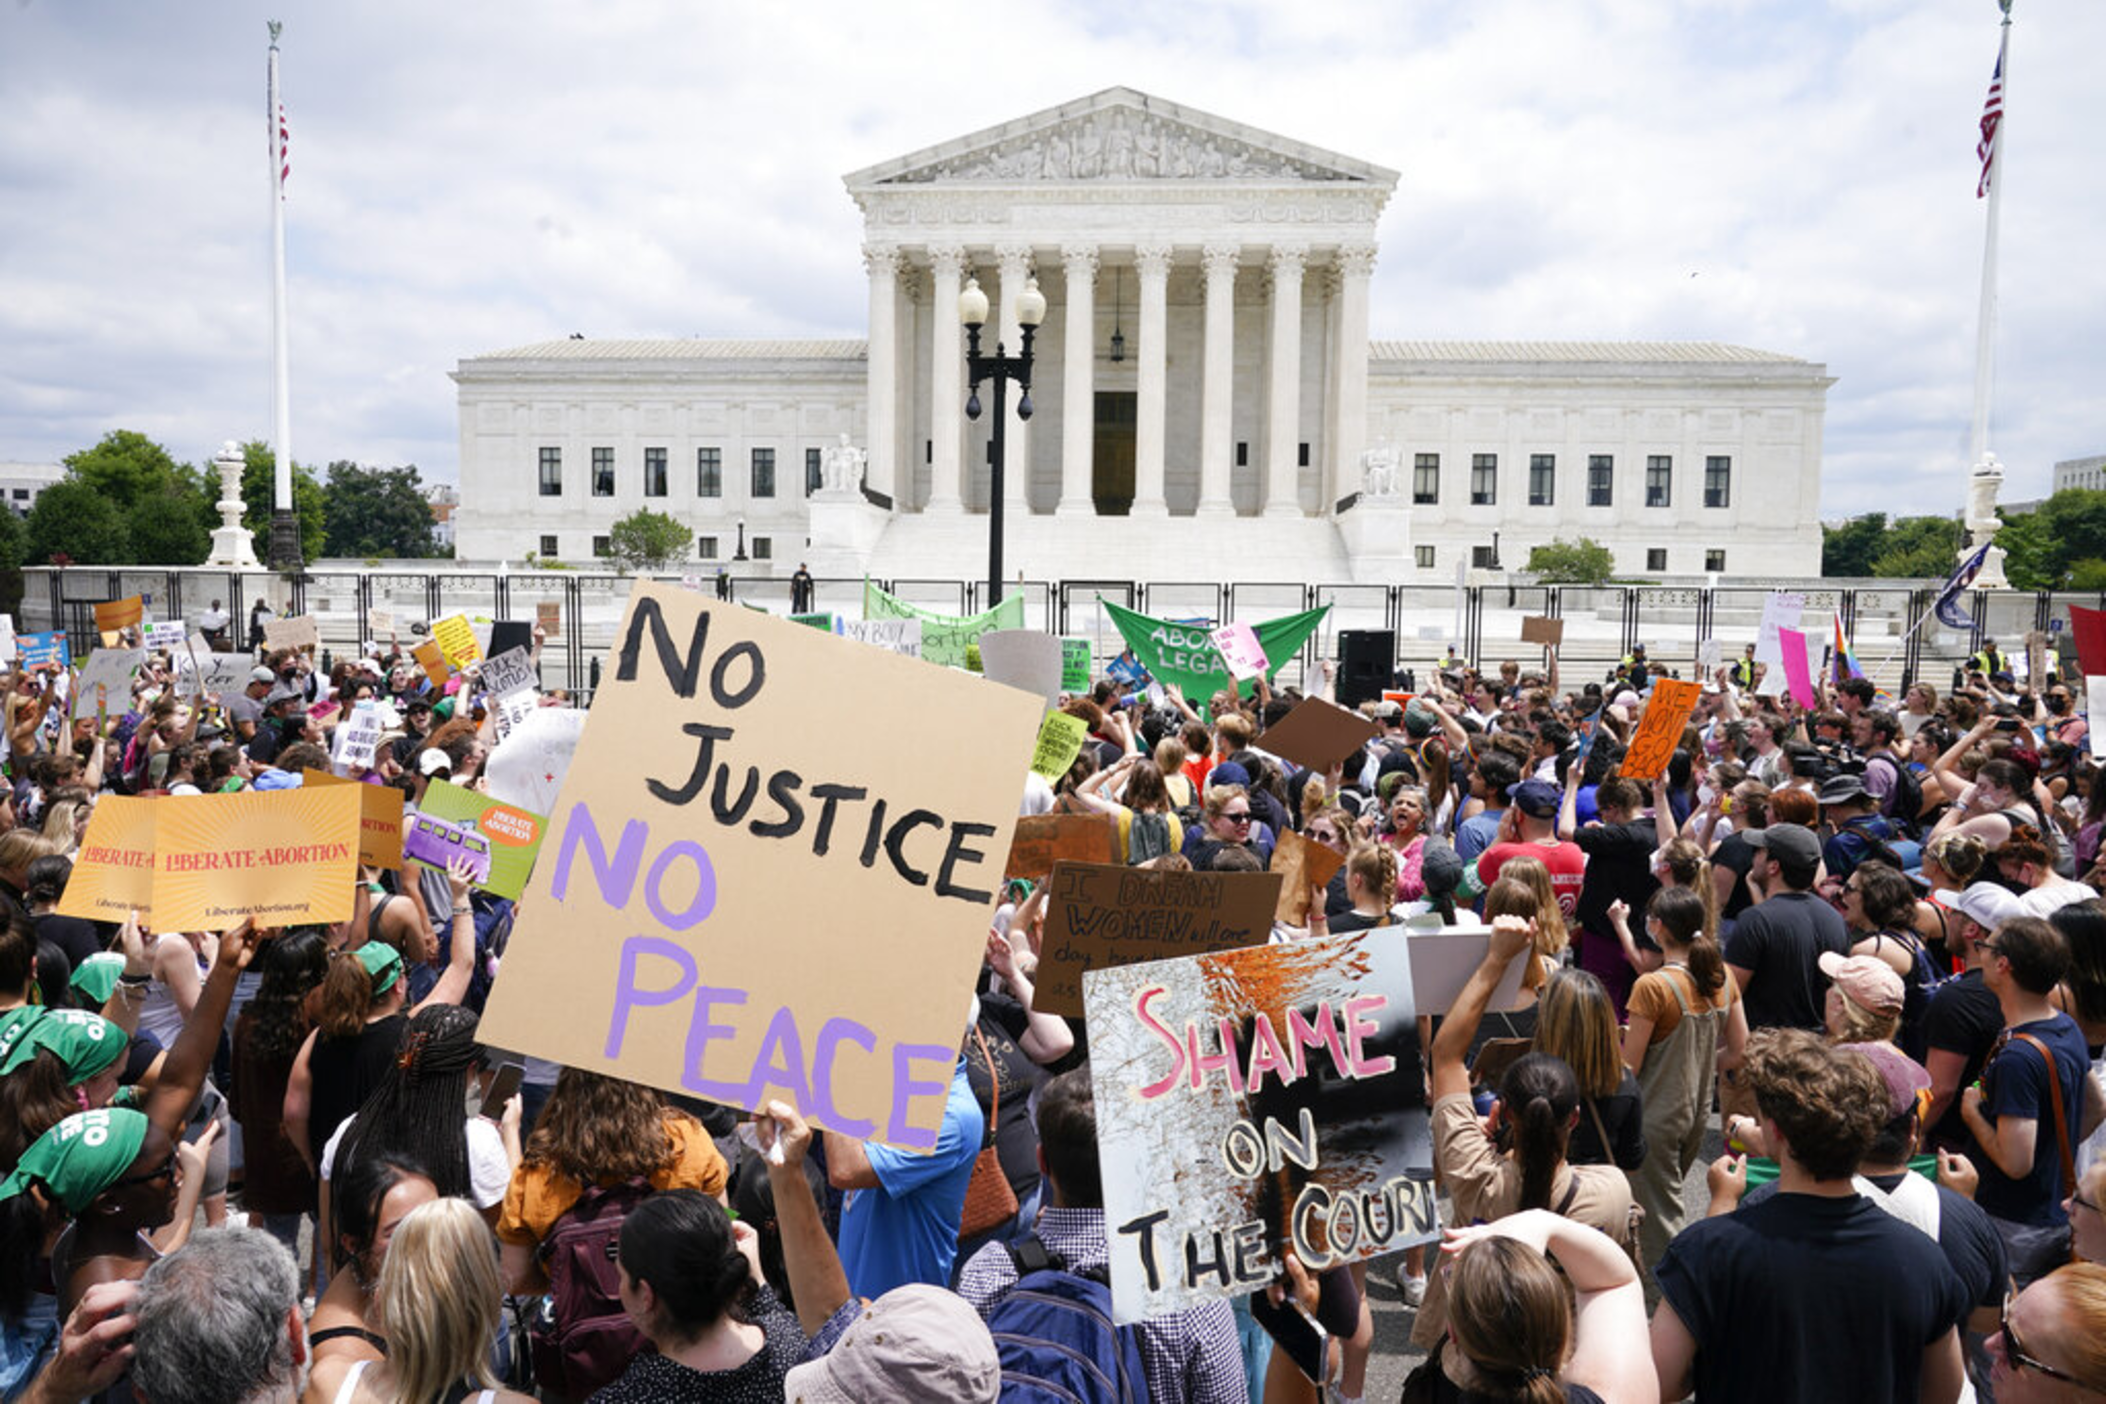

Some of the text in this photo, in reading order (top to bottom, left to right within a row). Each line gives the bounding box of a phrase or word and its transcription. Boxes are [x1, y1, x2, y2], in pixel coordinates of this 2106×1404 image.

[616, 597, 766, 709] NO
[1151, 626, 1219, 651] ABOR
[1158, 646, 1228, 675] LEGA
[361, 817, 397, 833] RTION
[646, 722, 996, 904] JUSTICE
[84, 846, 145, 868] LIBERATE
[166, 849, 256, 872] LIBERATE
[259, 842, 350, 866] ABORTION
[551, 802, 717, 932] NO
[1067, 904, 1193, 943] WOMEN
[604, 936, 955, 1148] PEACE
[1128, 985, 1396, 1101] SHAME
[1222, 1108, 1317, 1180] ON
[1119, 1167, 1437, 1293] THE COURT
